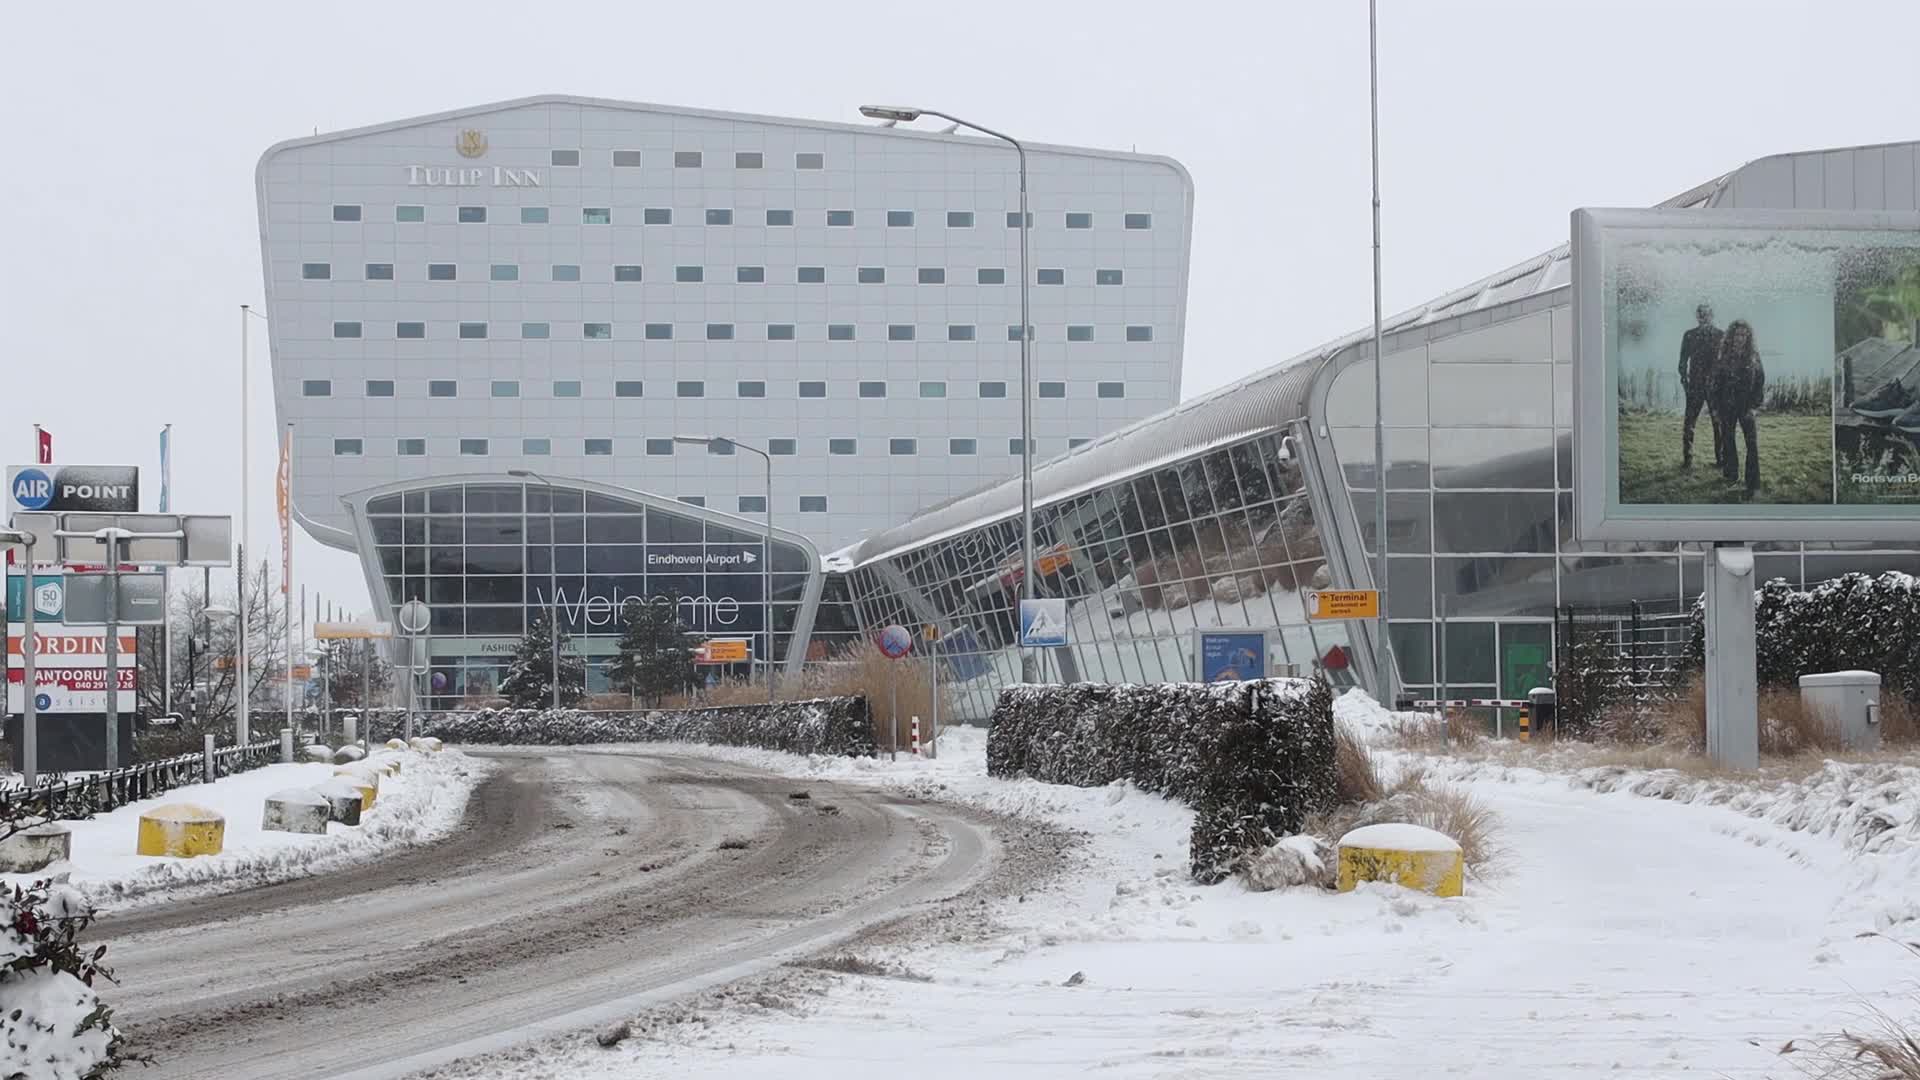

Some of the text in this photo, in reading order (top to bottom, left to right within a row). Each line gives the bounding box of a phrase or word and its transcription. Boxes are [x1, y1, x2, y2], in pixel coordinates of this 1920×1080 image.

[405, 165, 542, 186] TULIP INN
[1851, 473, 1885, 483] Floris
[1886, 475, 1906, 483] van
[15, 479, 130, 499] AIR POINT
[648, 554, 740, 566] Eindhoven Airport
[42, 590, 57, 601] 50
[1330, 591, 1368, 601] Terminal
[536, 586, 740, 626] Welcome
[20, 637, 125, 655] ORDINA
[481, 643, 520, 652] FASHIO
[34, 670, 134, 681] ANTOORUTS
[122, 681, 134, 689] 26
